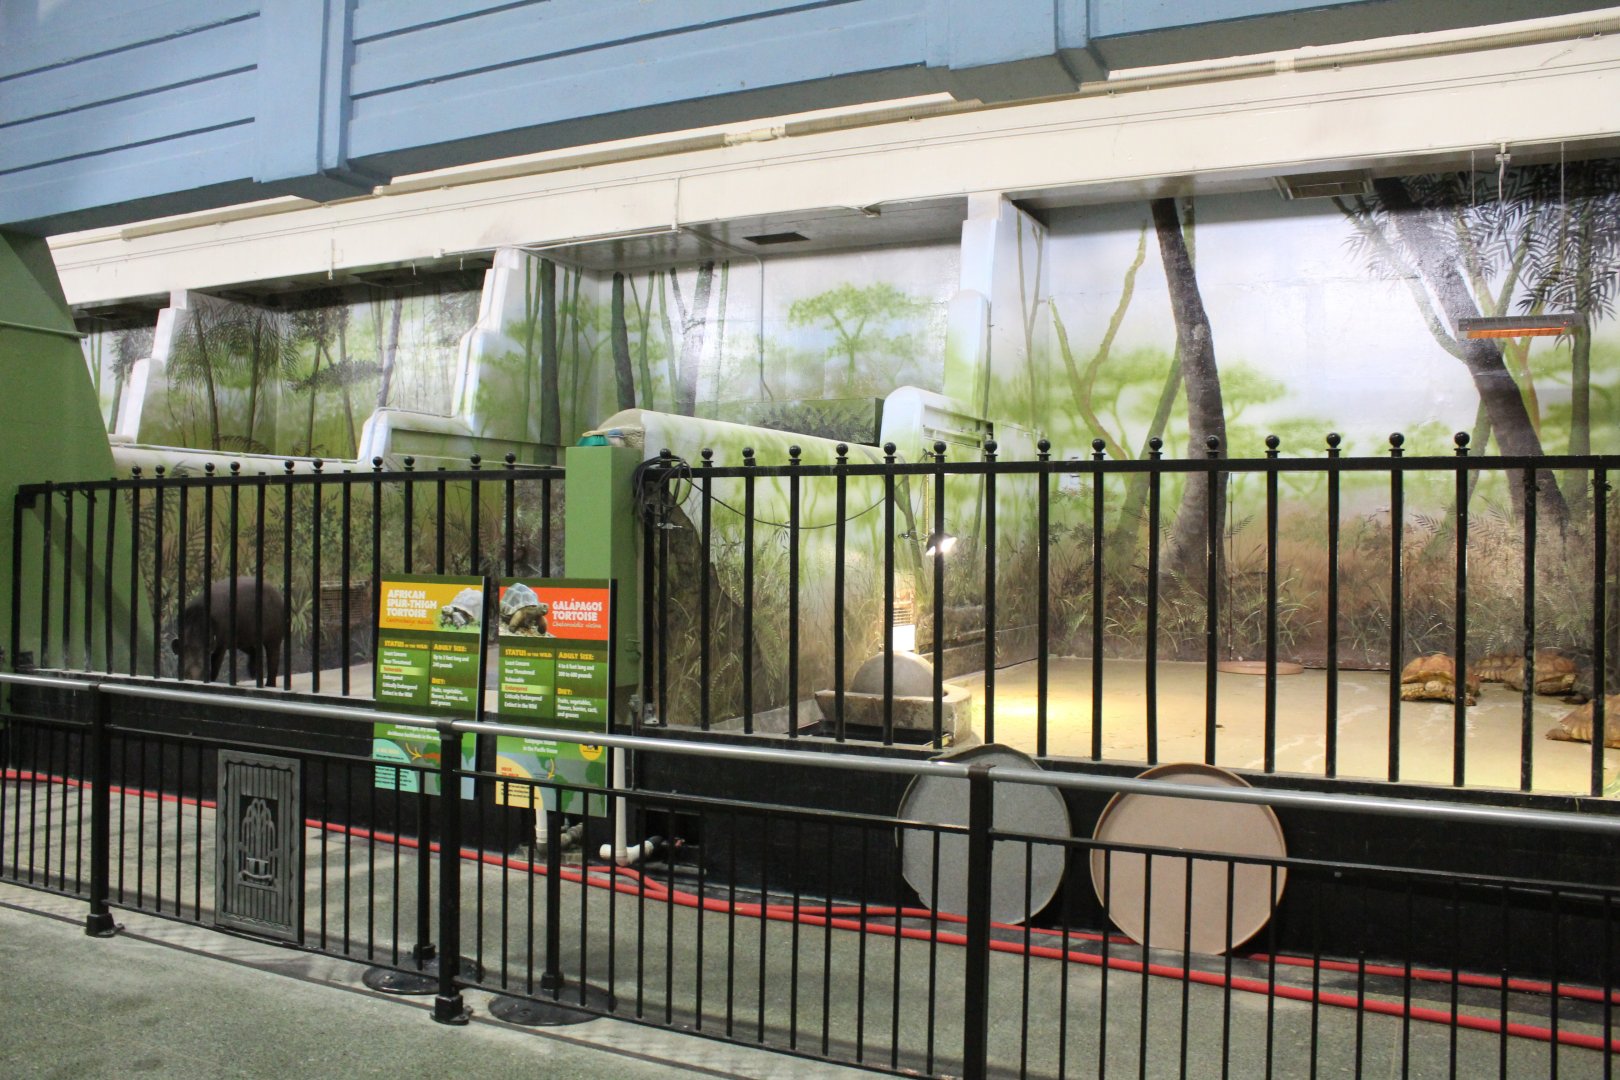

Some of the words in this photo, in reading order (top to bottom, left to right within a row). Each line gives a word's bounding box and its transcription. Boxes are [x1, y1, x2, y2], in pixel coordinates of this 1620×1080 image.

[388, 589, 426, 600] AFRICAN
[388, 598, 438, 609] SPUR-THIGH
[552, 598, 602, 612] GALÁPAGOS
[387, 608, 427, 618] TORTOISE
[552, 610, 598, 621] TORTOISE
[505, 648, 527, 656] STATUS
[558, 652, 578, 660] ADULT
